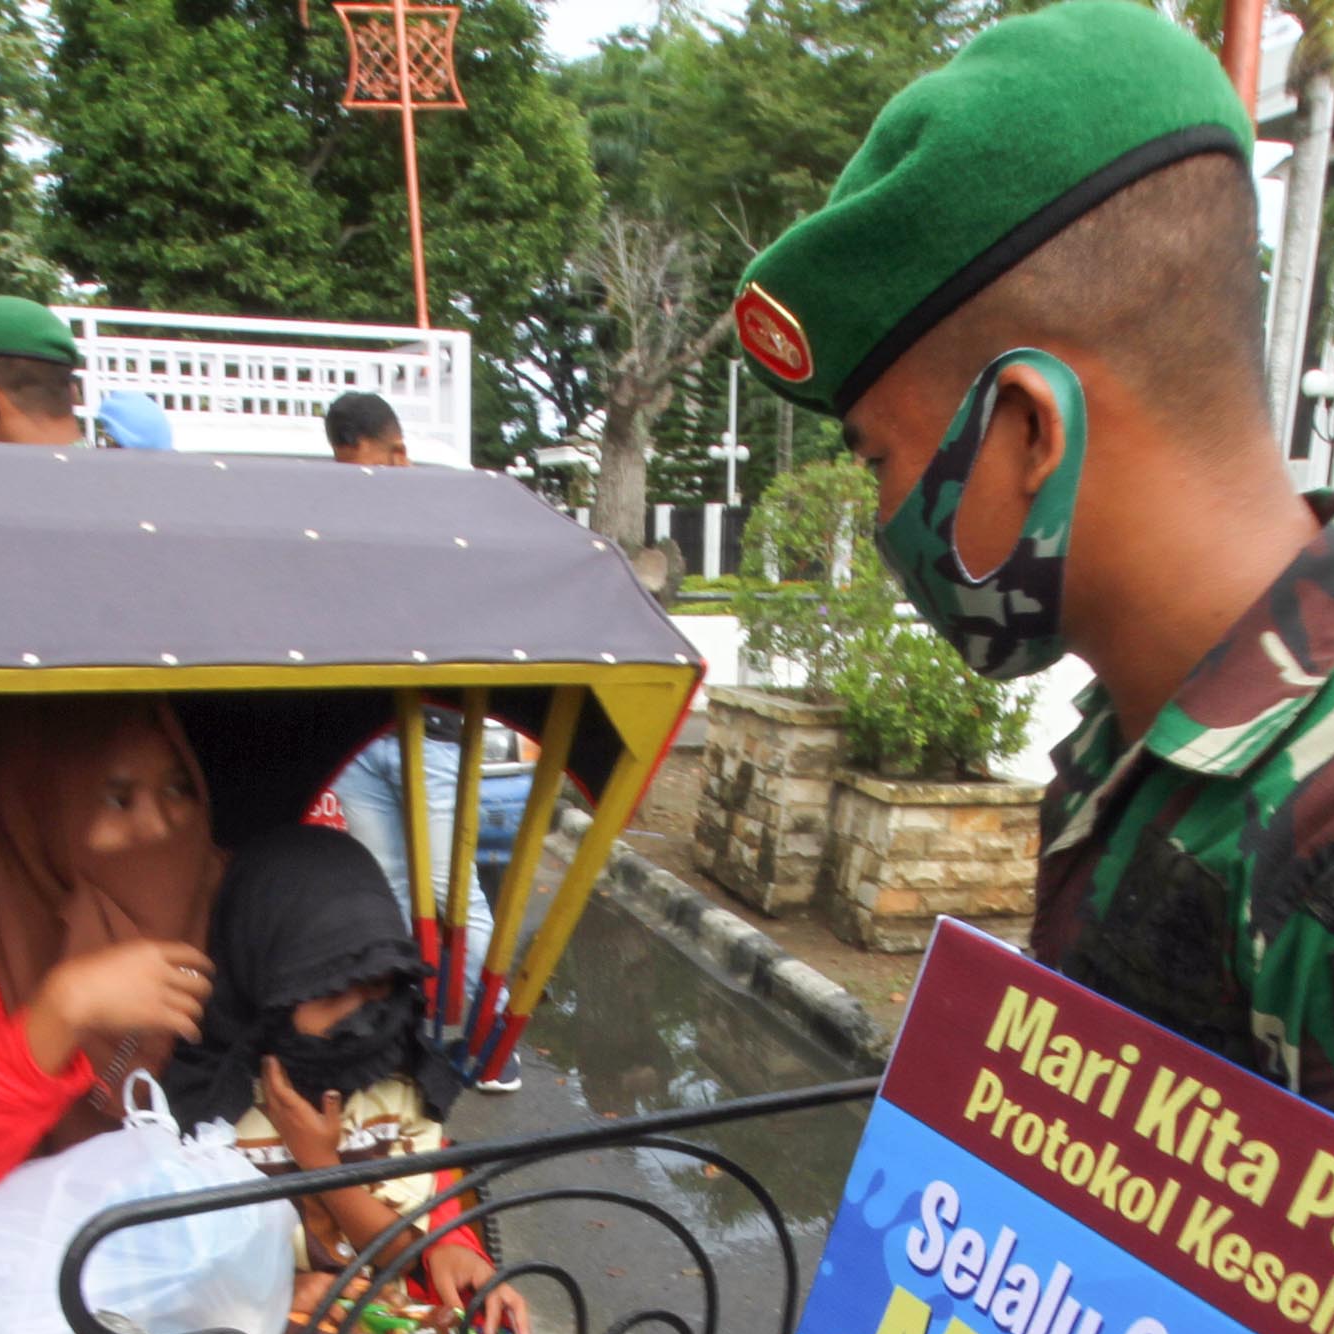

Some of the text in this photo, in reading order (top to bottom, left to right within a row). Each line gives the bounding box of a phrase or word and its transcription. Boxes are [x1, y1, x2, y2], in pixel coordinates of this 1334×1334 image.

[963, 1066, 1181, 1234] Protokol
[984, 985, 1141, 1118] Mari
[1133, 1067, 1281, 1206] Kita
